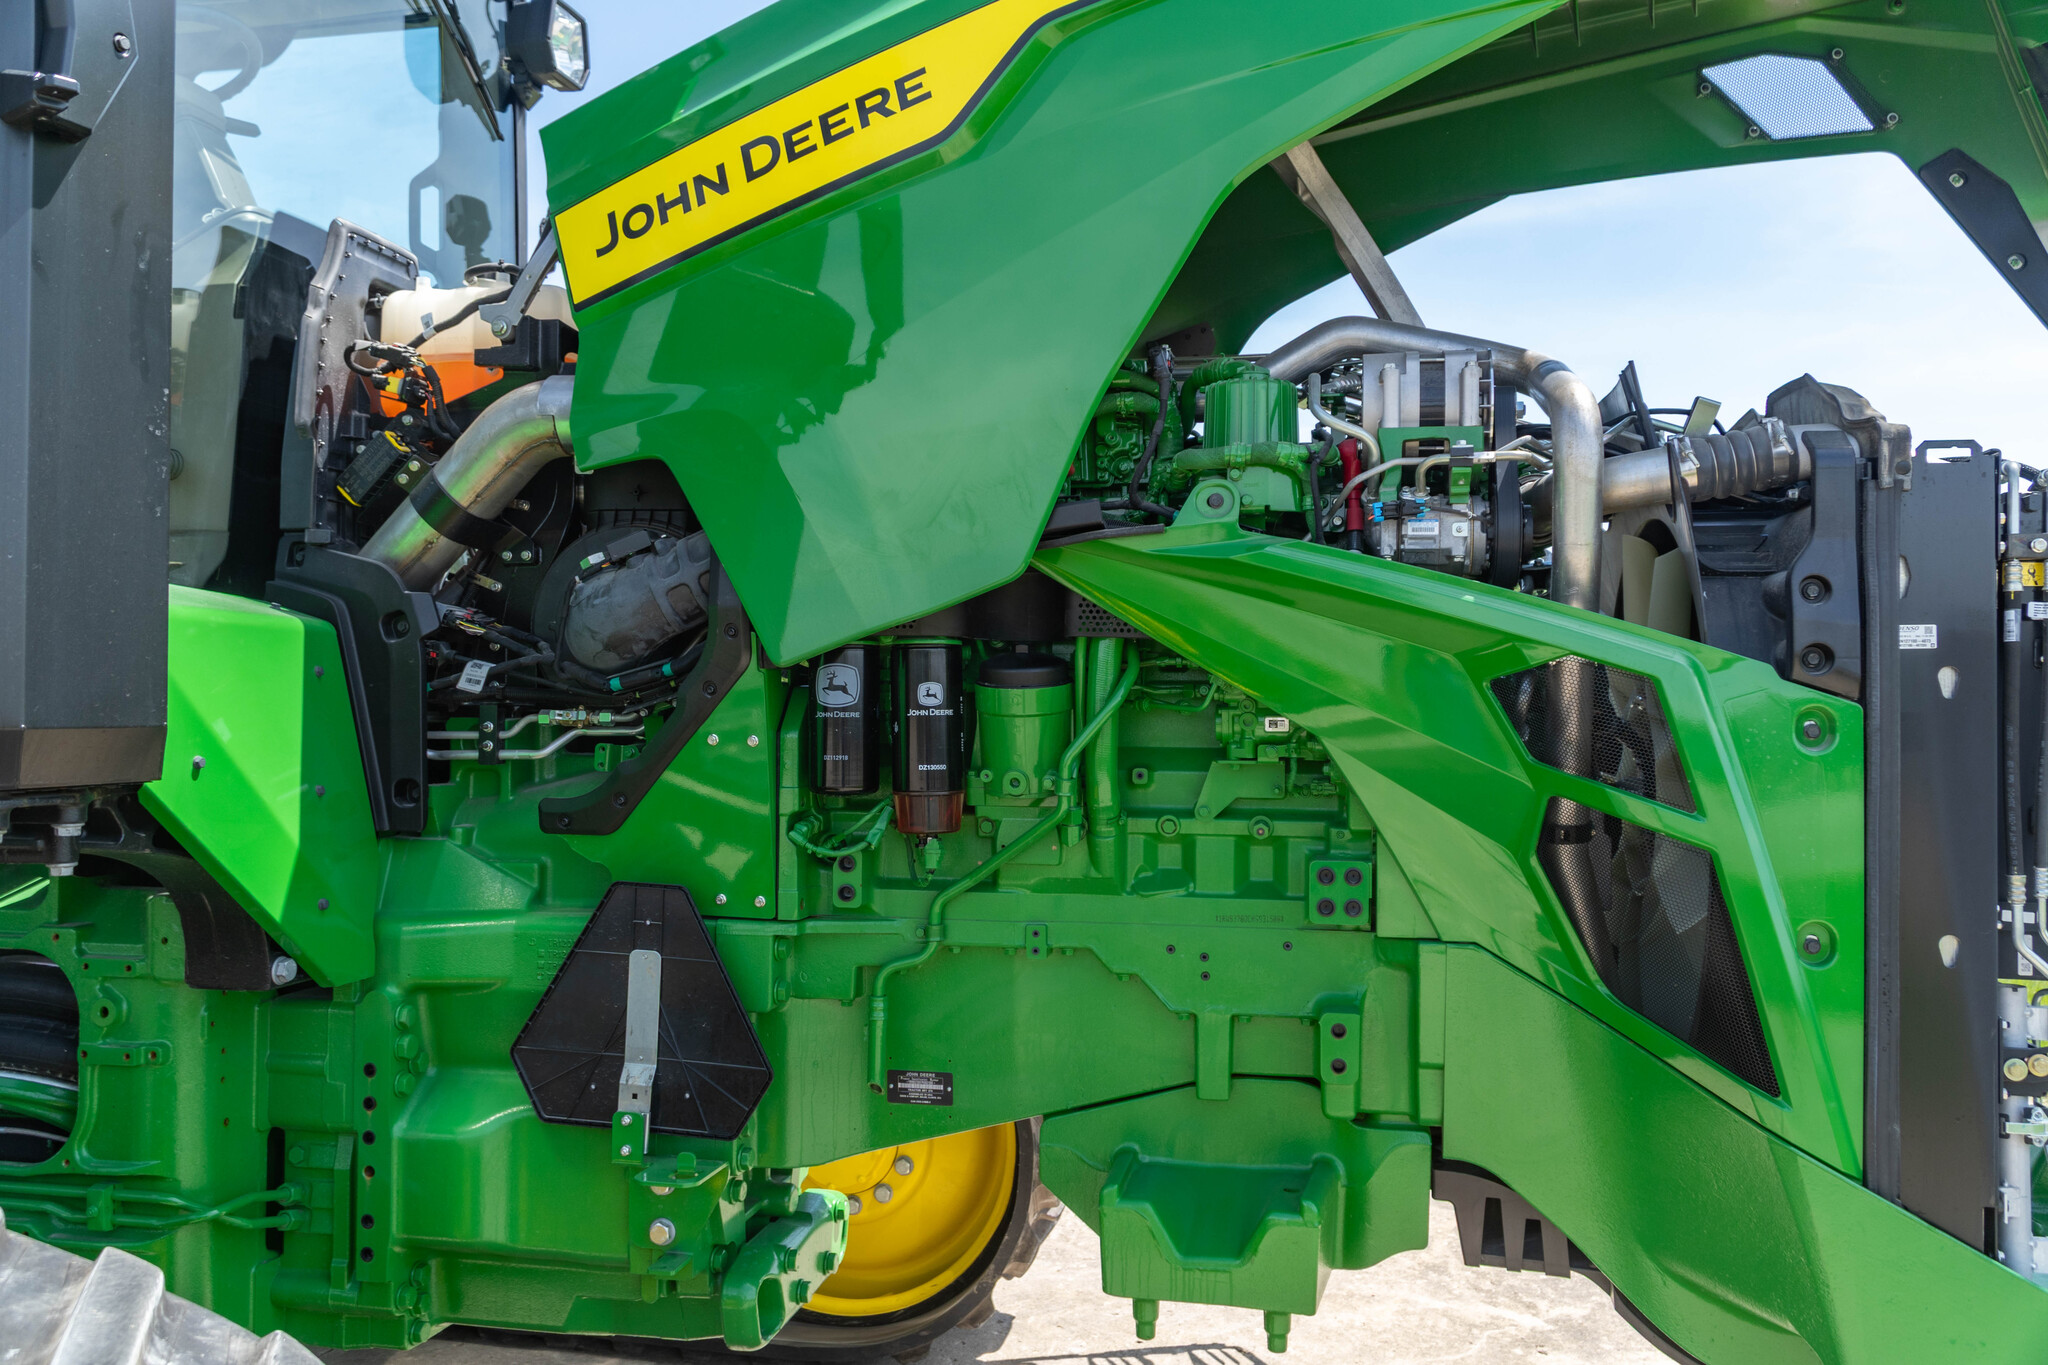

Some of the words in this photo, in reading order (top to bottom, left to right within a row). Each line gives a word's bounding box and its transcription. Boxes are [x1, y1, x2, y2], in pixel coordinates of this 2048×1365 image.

[595, 162, 730, 259] JOHN
[740, 66, 933, 183] DEERE
[833, 710, 861, 718] DEERE
[907, 708, 929, 716] JOHN
[929, 708, 954, 716] DEERE
